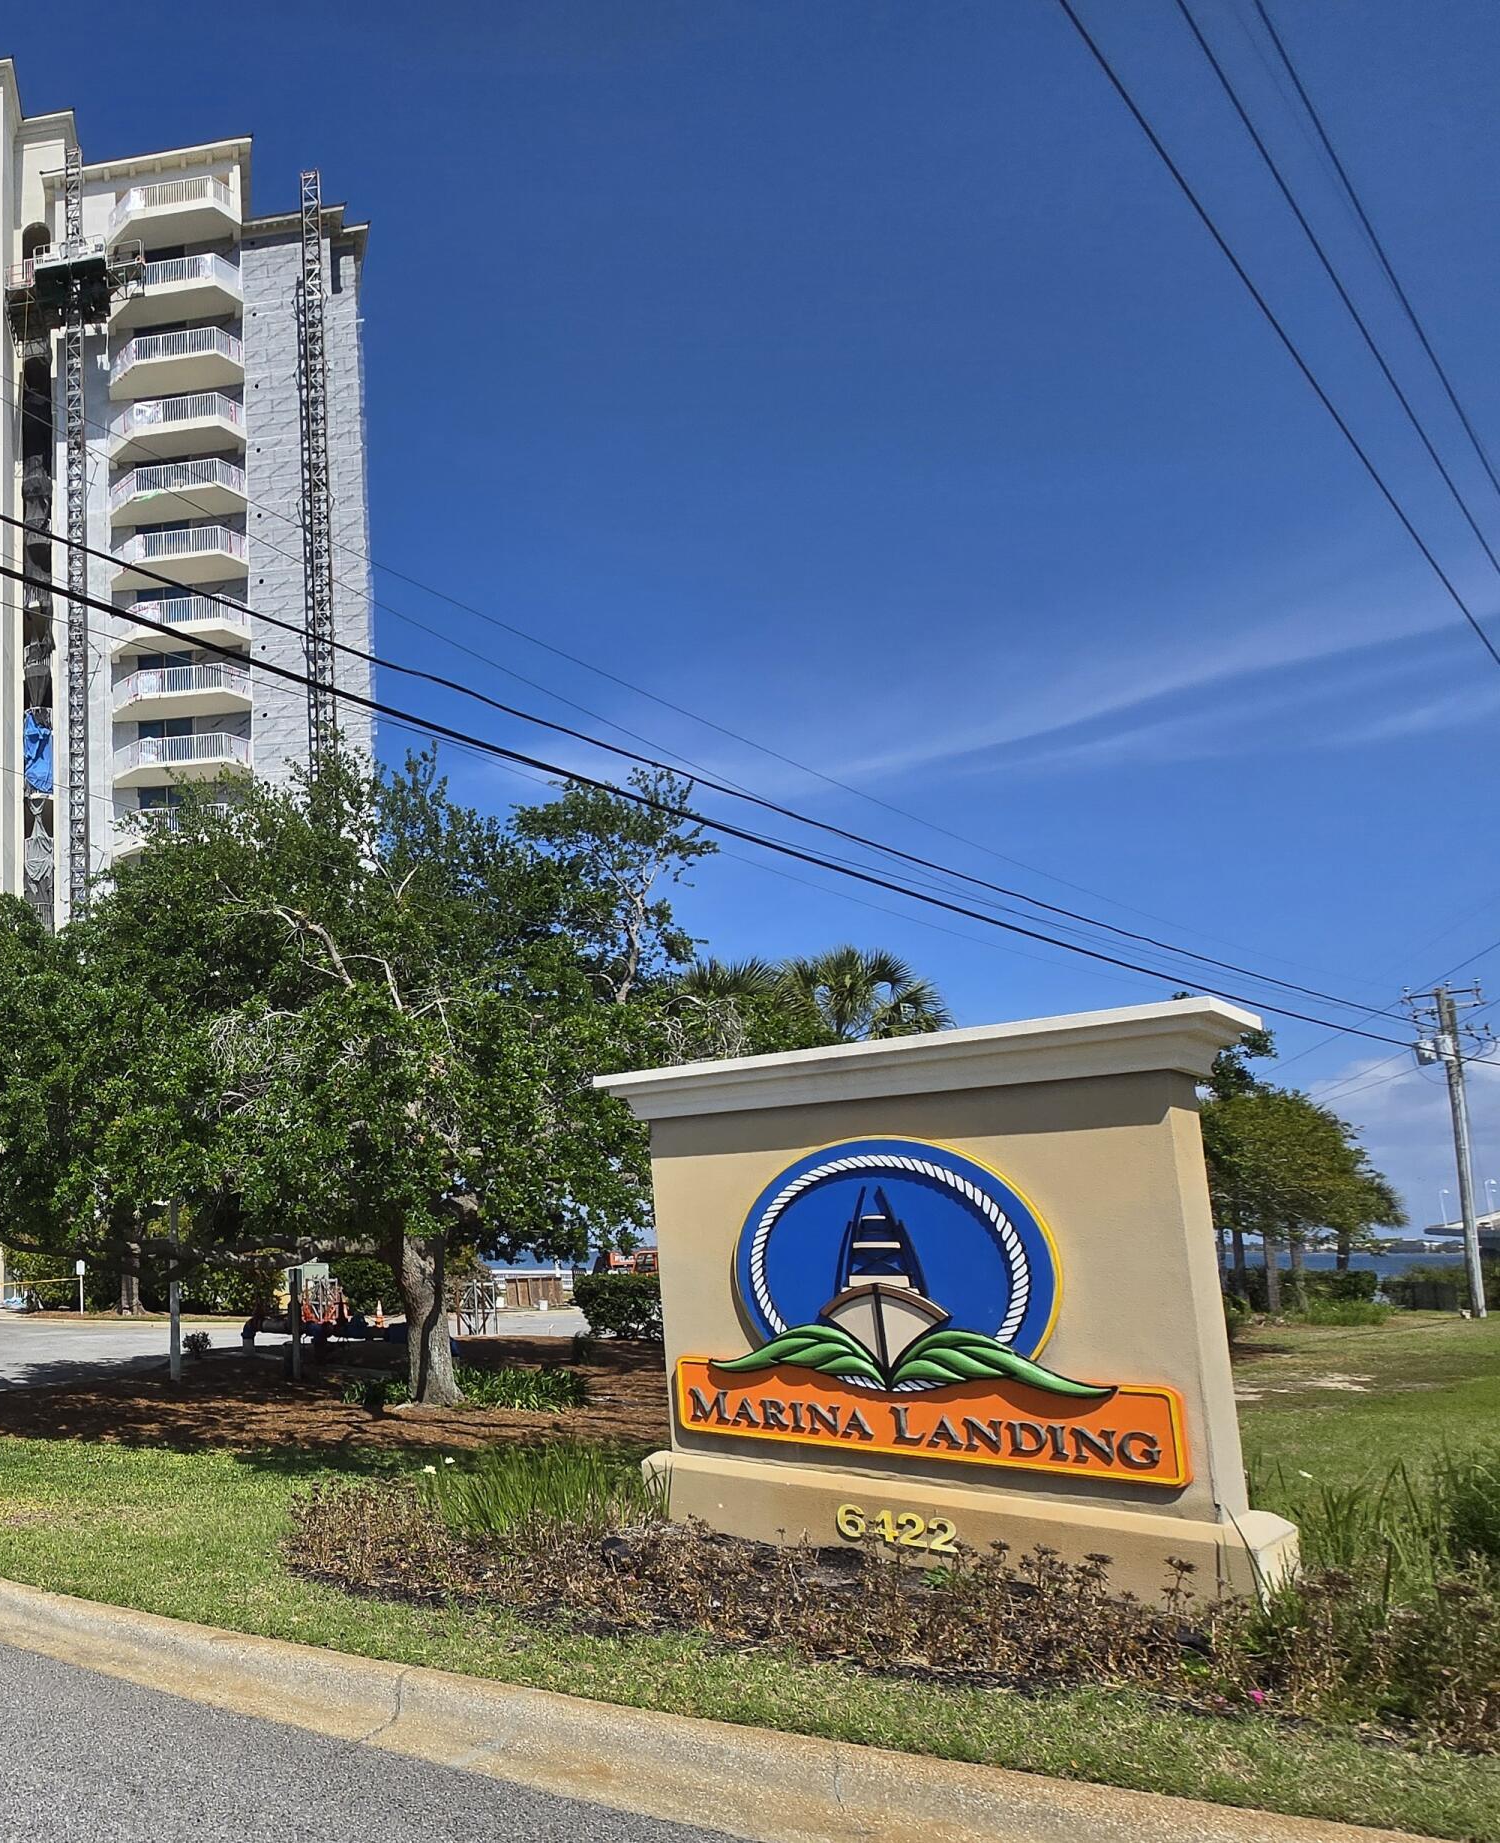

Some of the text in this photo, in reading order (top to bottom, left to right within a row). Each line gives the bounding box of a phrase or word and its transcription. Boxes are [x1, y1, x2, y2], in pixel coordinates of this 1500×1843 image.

[688, 1387, 1162, 1470] MARINA LANDING
[836, 1504, 960, 1554] 6422
